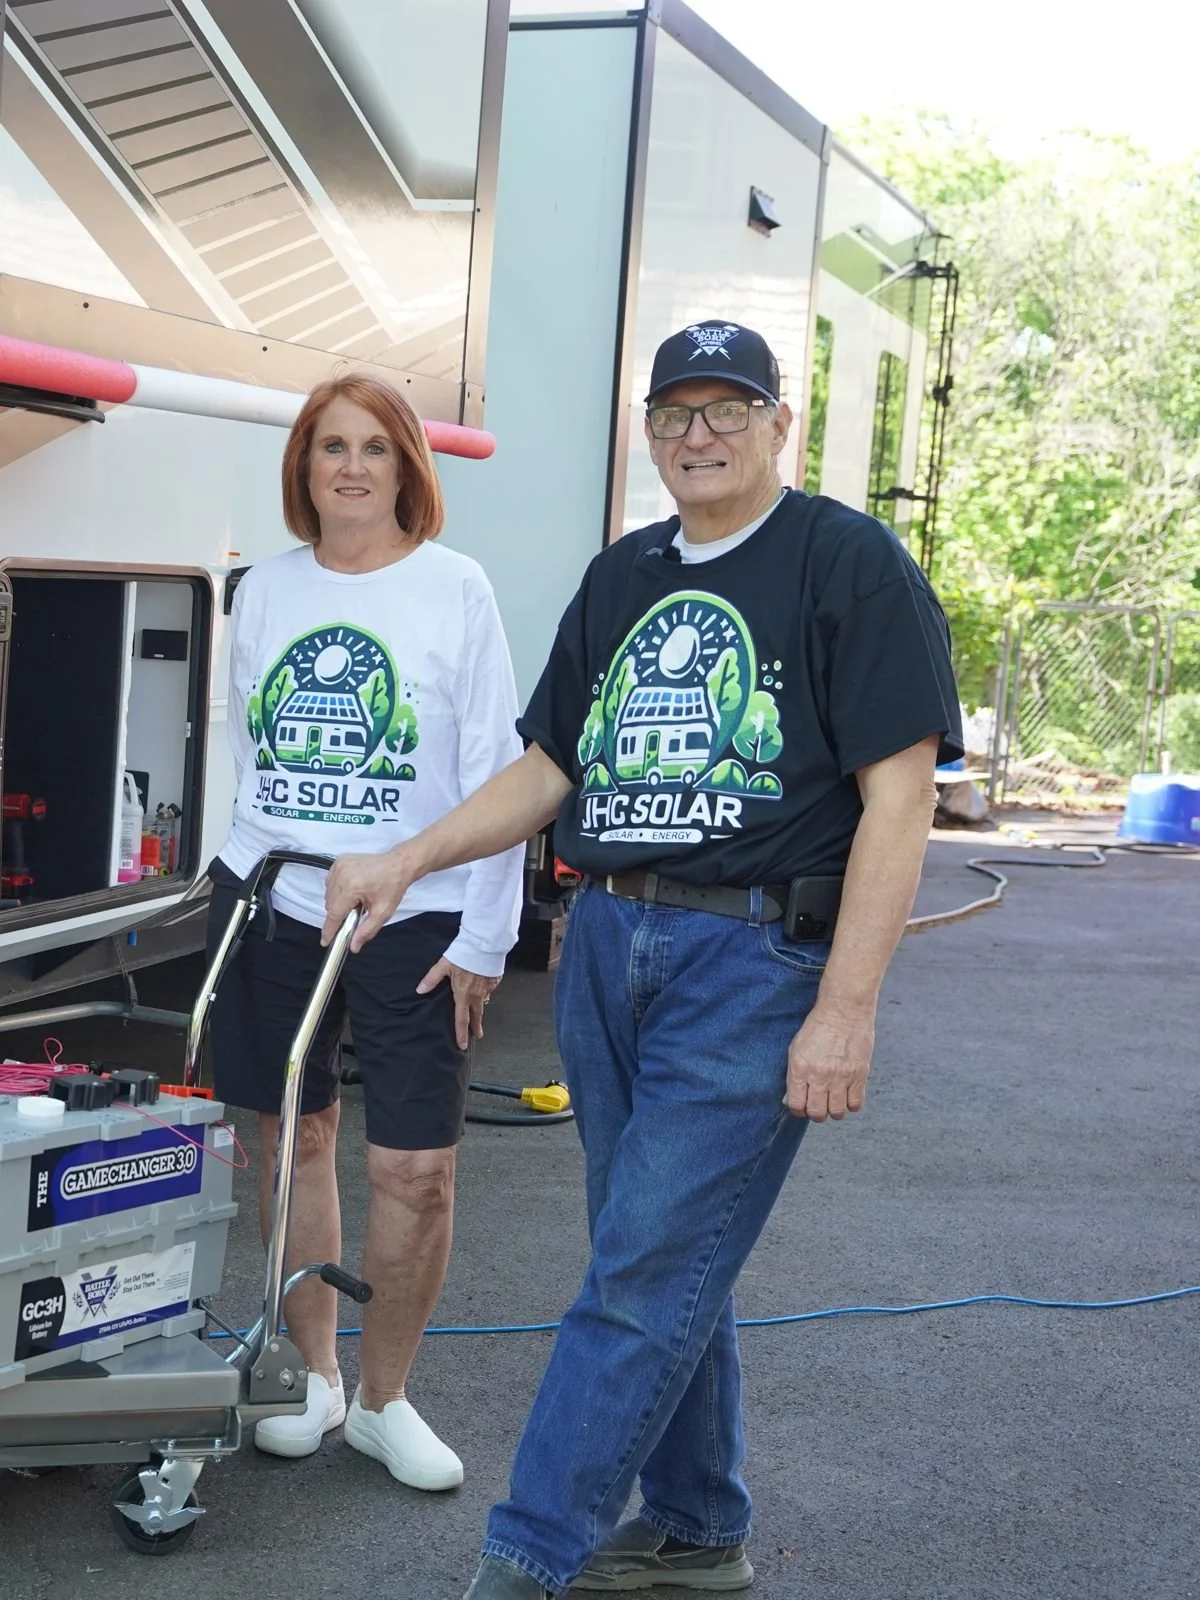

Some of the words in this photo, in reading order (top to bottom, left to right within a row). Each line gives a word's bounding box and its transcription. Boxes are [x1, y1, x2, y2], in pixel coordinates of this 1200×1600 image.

[693, 329, 731, 338] BATTLE
[297, 781, 400, 813] SOLAR
[270, 807, 299, 818] SOLAR
[323, 813, 367, 824] ENERGY
[581, 795, 630, 829] JHC
[630, 793, 743, 829] SOLAR
[607, 831, 634, 840] SOLAR
[652, 831, 692, 841] ENERGY
[64, 1152, 175, 1192] GAMECHANGER
[36, 1171, 49, 1208] THE
[84, 1279, 111, 1293] BATTLE
[22, 1295, 64, 1321] GC3H
